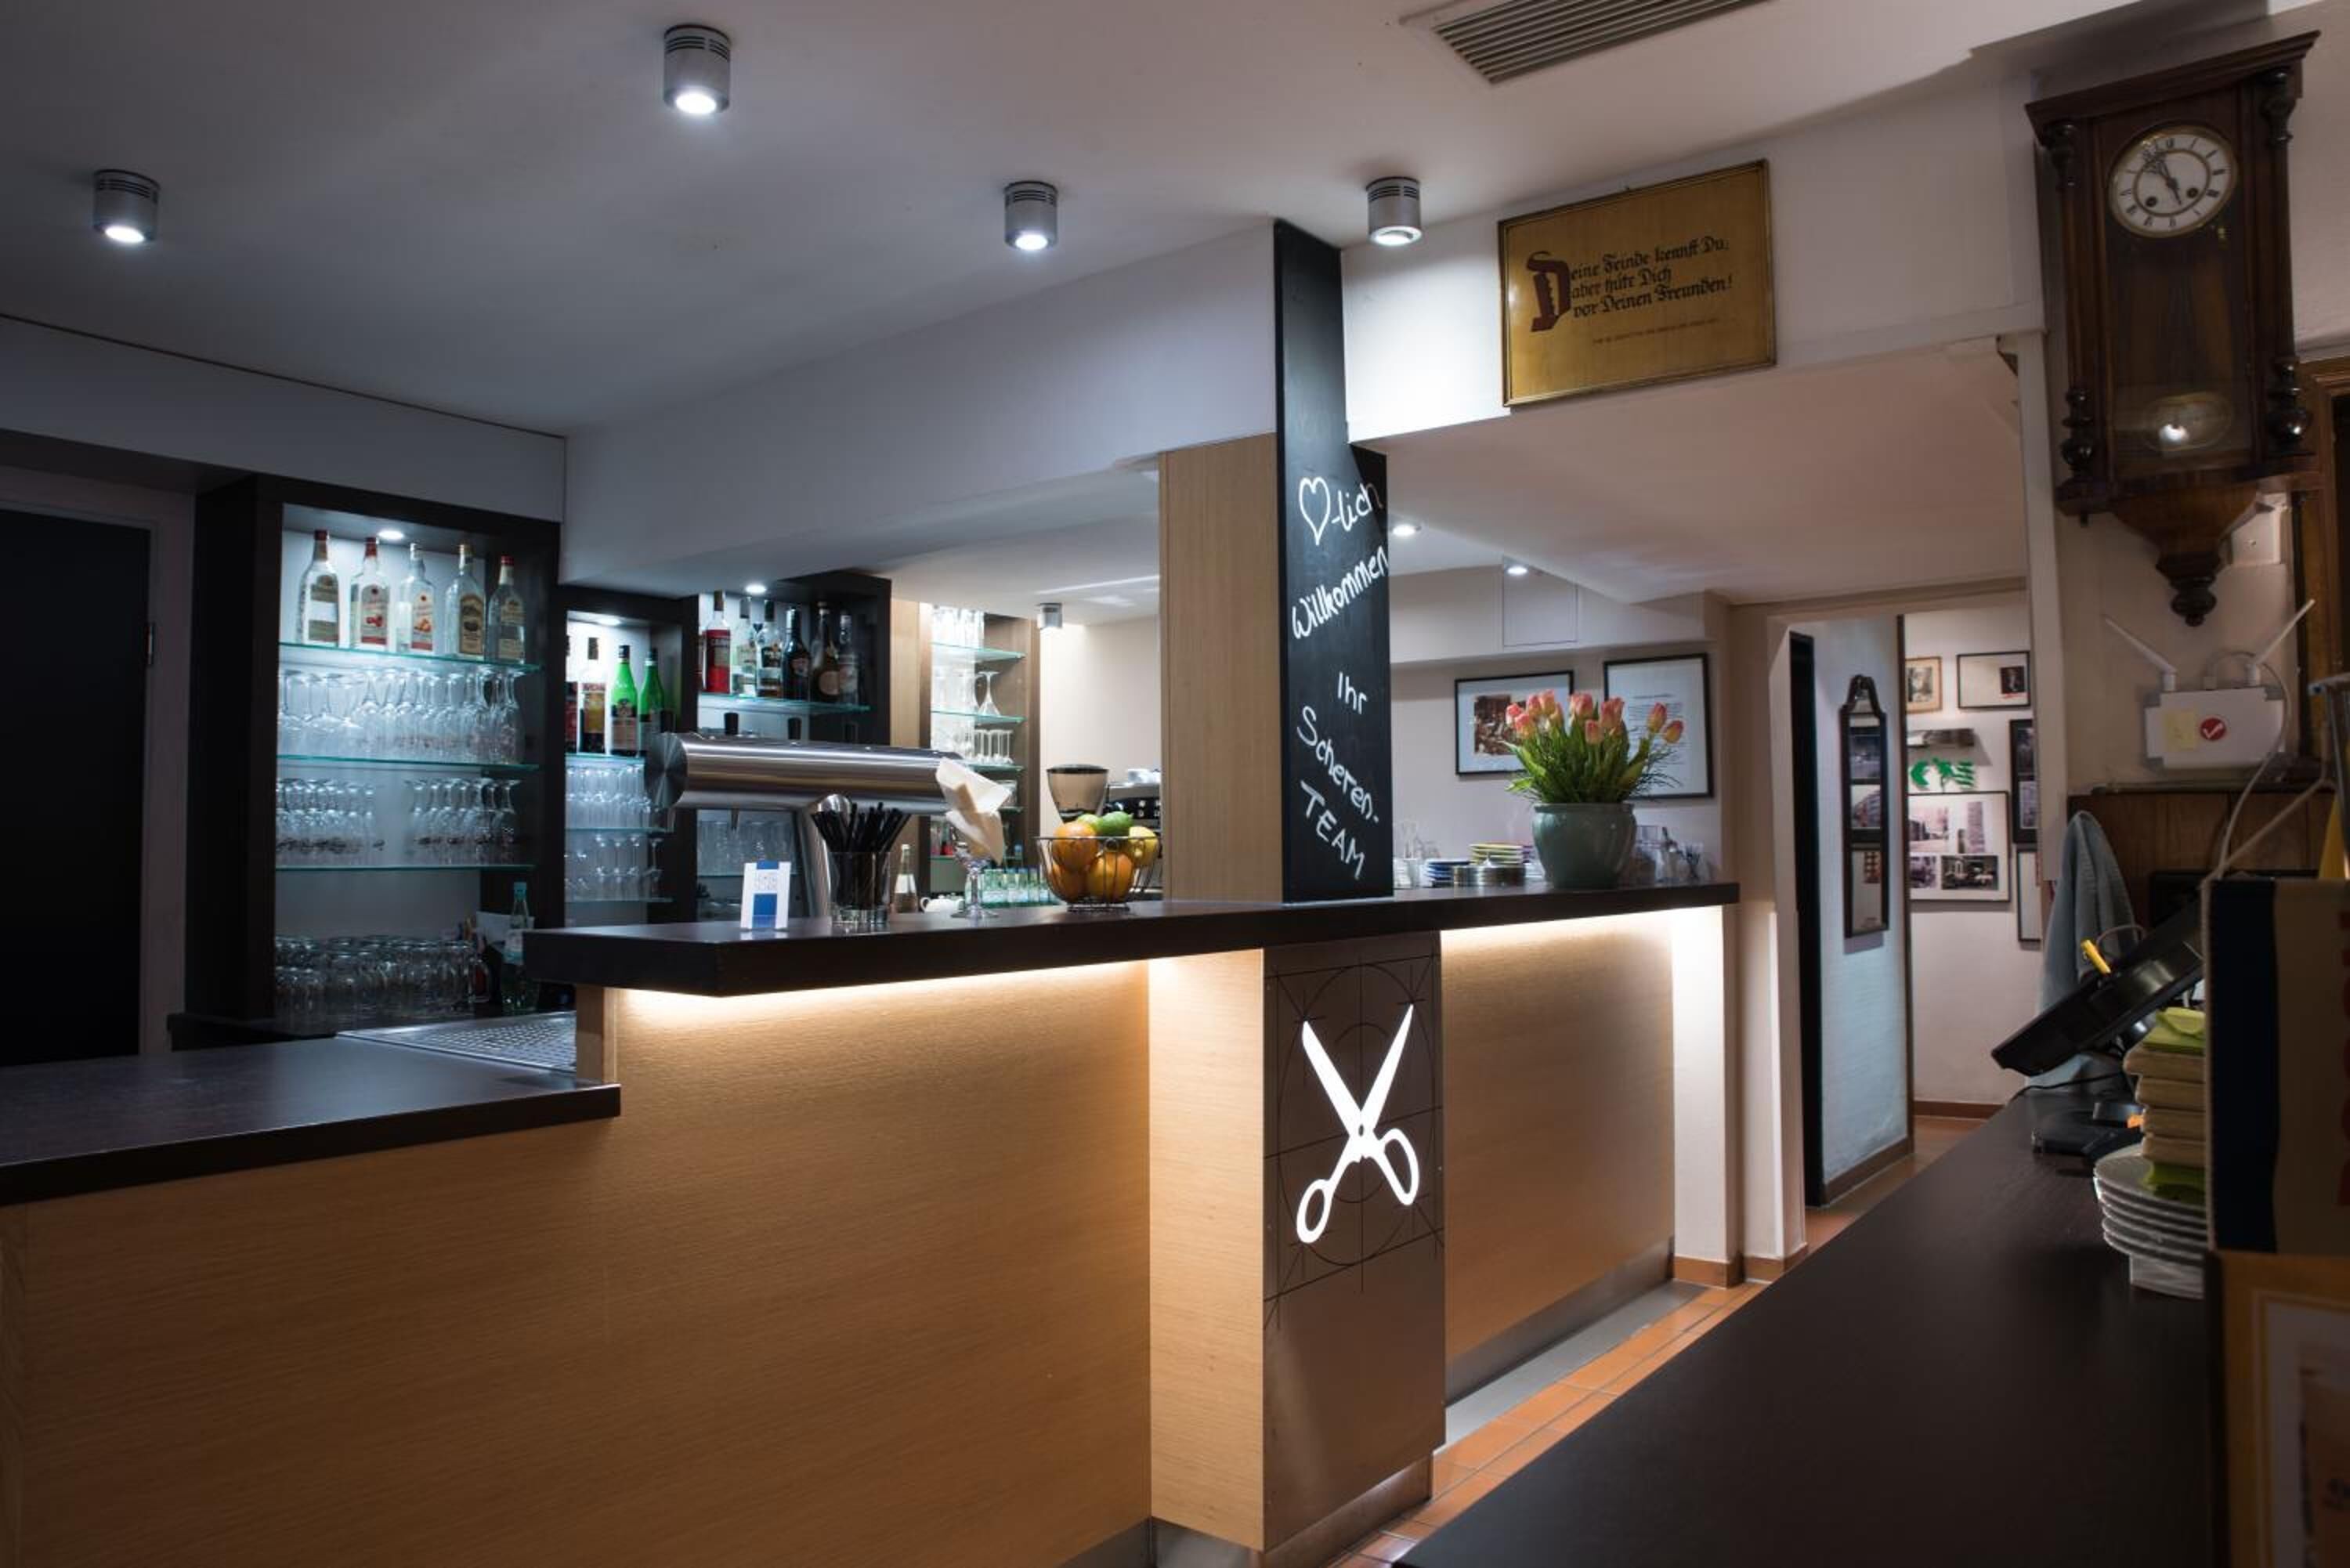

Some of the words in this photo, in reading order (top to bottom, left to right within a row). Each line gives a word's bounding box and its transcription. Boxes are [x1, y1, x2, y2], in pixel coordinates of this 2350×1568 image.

[1527, 251, 1600, 332] Deine
[1603, 253, 1650, 273] Feinde
[1571, 280, 1602, 299] aber
[1637, 268, 1672, 288] Dich
[1573, 302, 1599, 318] vor
[1600, 293, 1652, 314] Deinen
[1654, 274, 1733, 302] Freunden!
[1291, 545, 1390, 640] Willkommen
[1337, 671, 1368, 715] Ihr
[1300, 780, 1365, 880] TEAM
